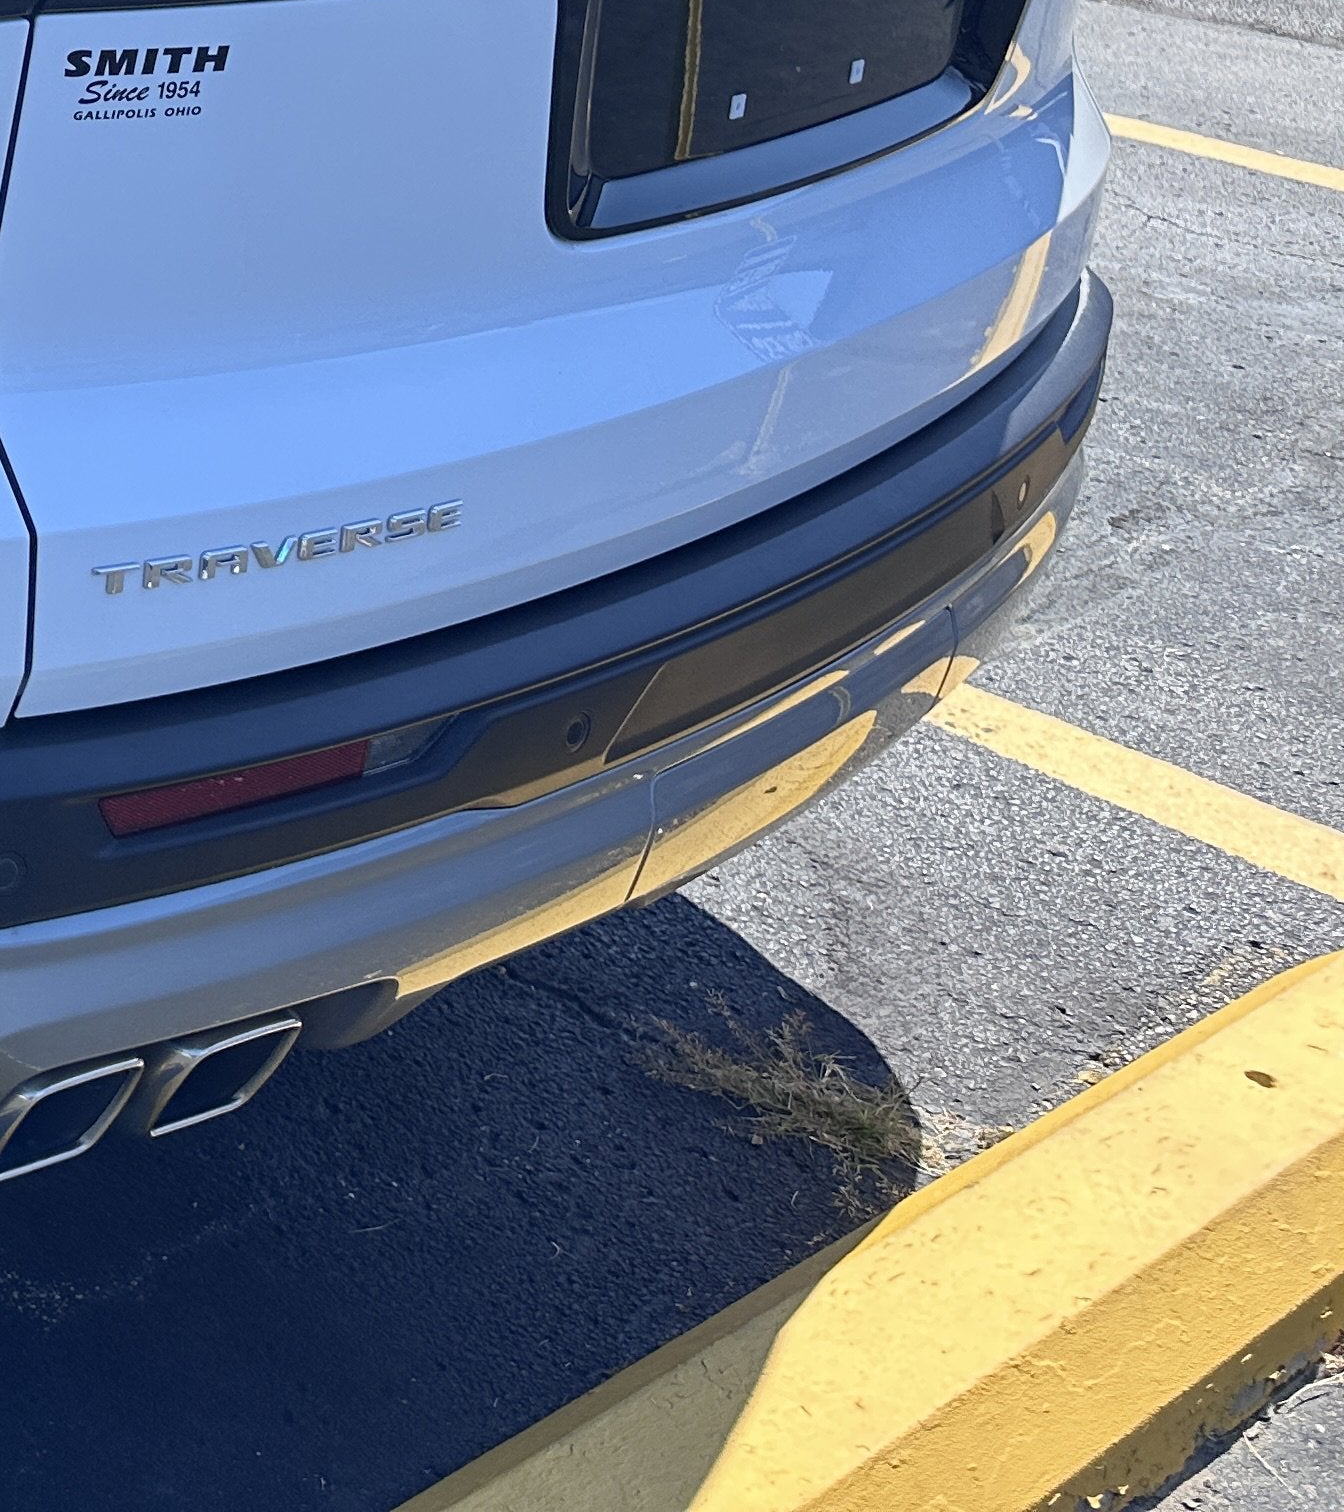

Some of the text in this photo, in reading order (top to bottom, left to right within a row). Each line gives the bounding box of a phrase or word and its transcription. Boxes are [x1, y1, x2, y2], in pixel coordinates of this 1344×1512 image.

[64, 45, 230, 77] SMITH
[78, 80, 201, 104] Since 1954
[73, 106, 202, 120] GALLIPOLIS OHIO
[91, 498, 463, 594] TRAVERSE
